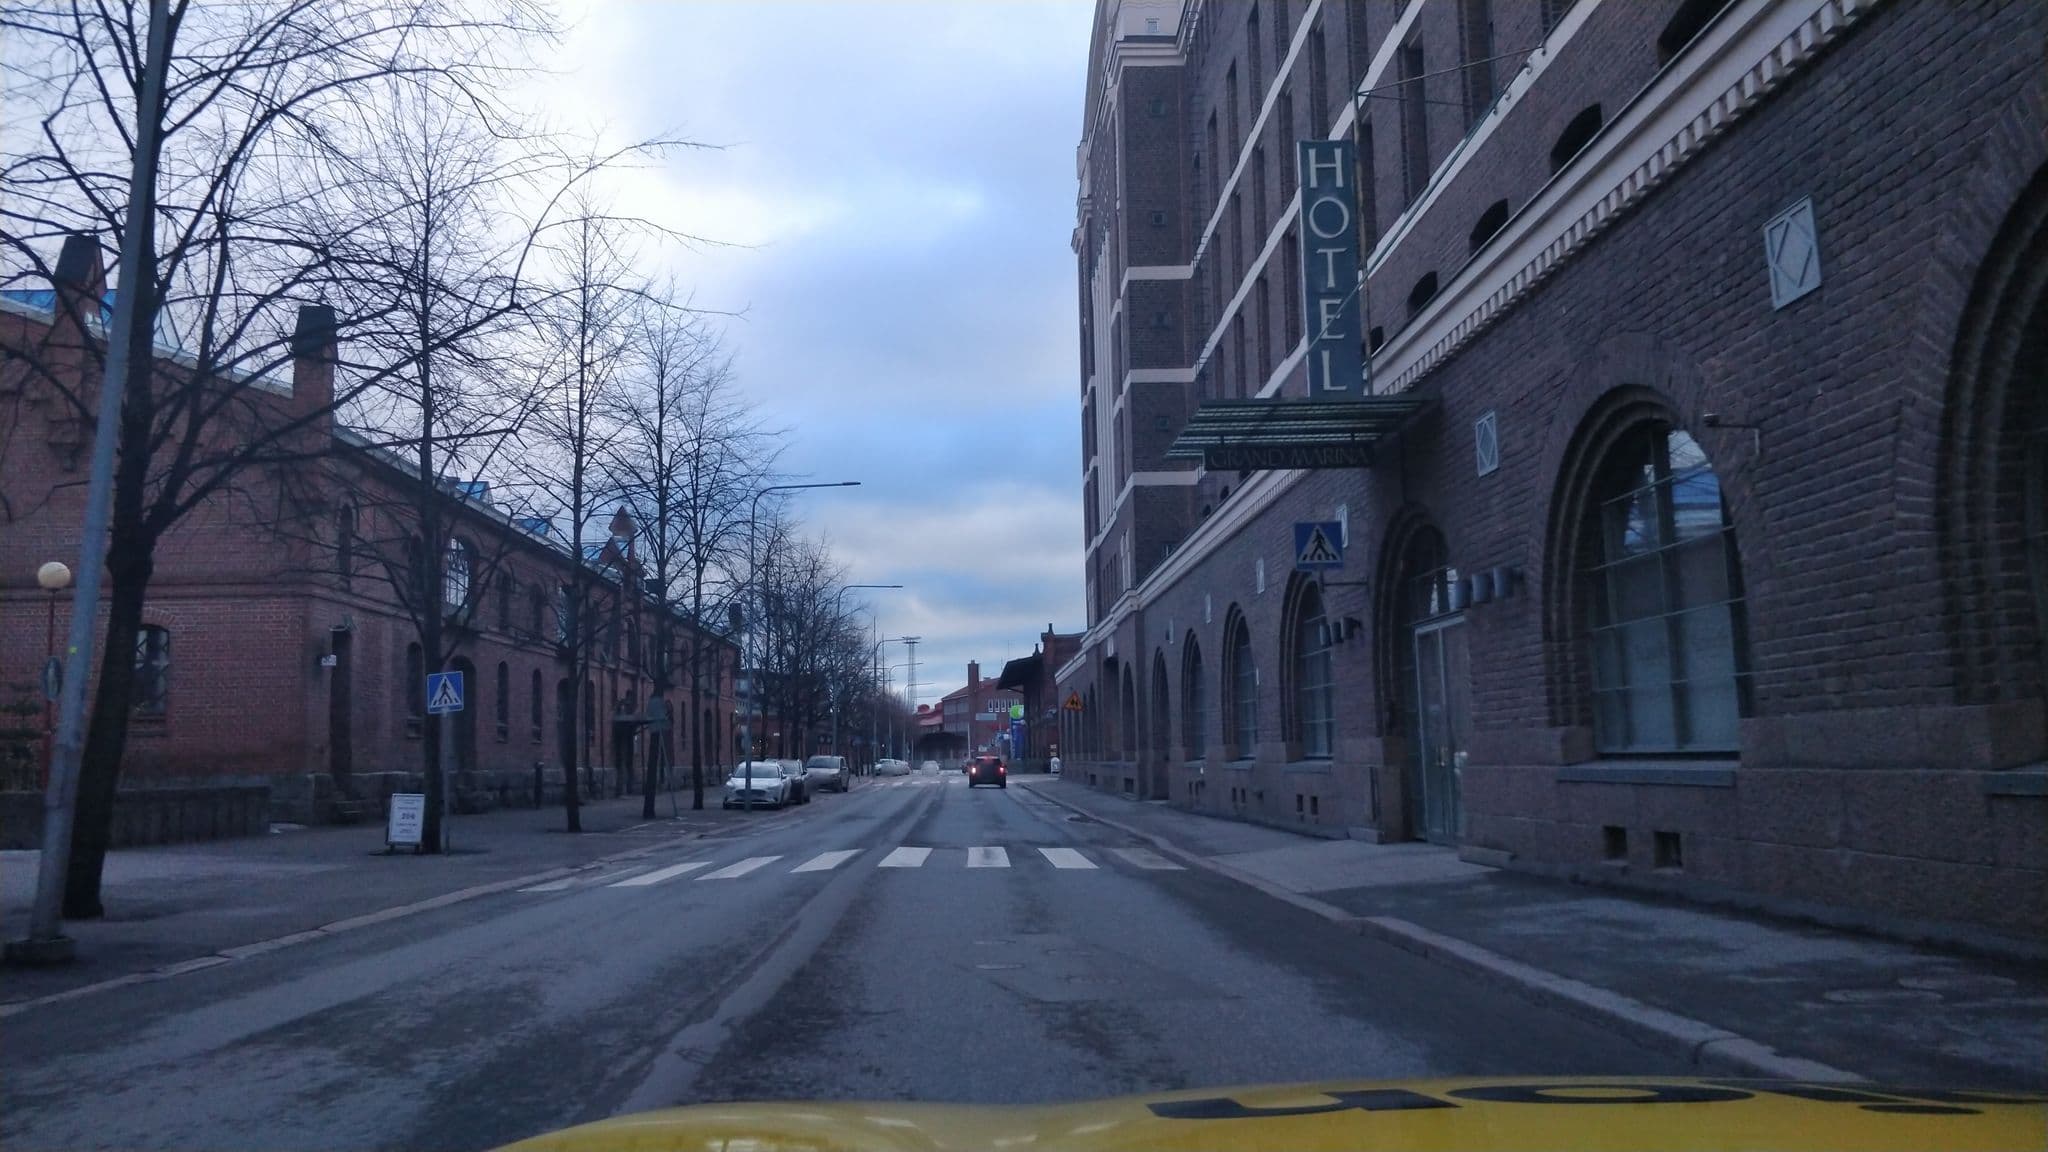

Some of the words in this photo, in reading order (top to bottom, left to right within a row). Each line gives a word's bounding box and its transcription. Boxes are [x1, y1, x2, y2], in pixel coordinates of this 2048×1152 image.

[1307, 147, 1349, 391] HOTEL
[1209, 448, 1285, 467] GRAND
[1291, 446, 1369, 467] MARINA
